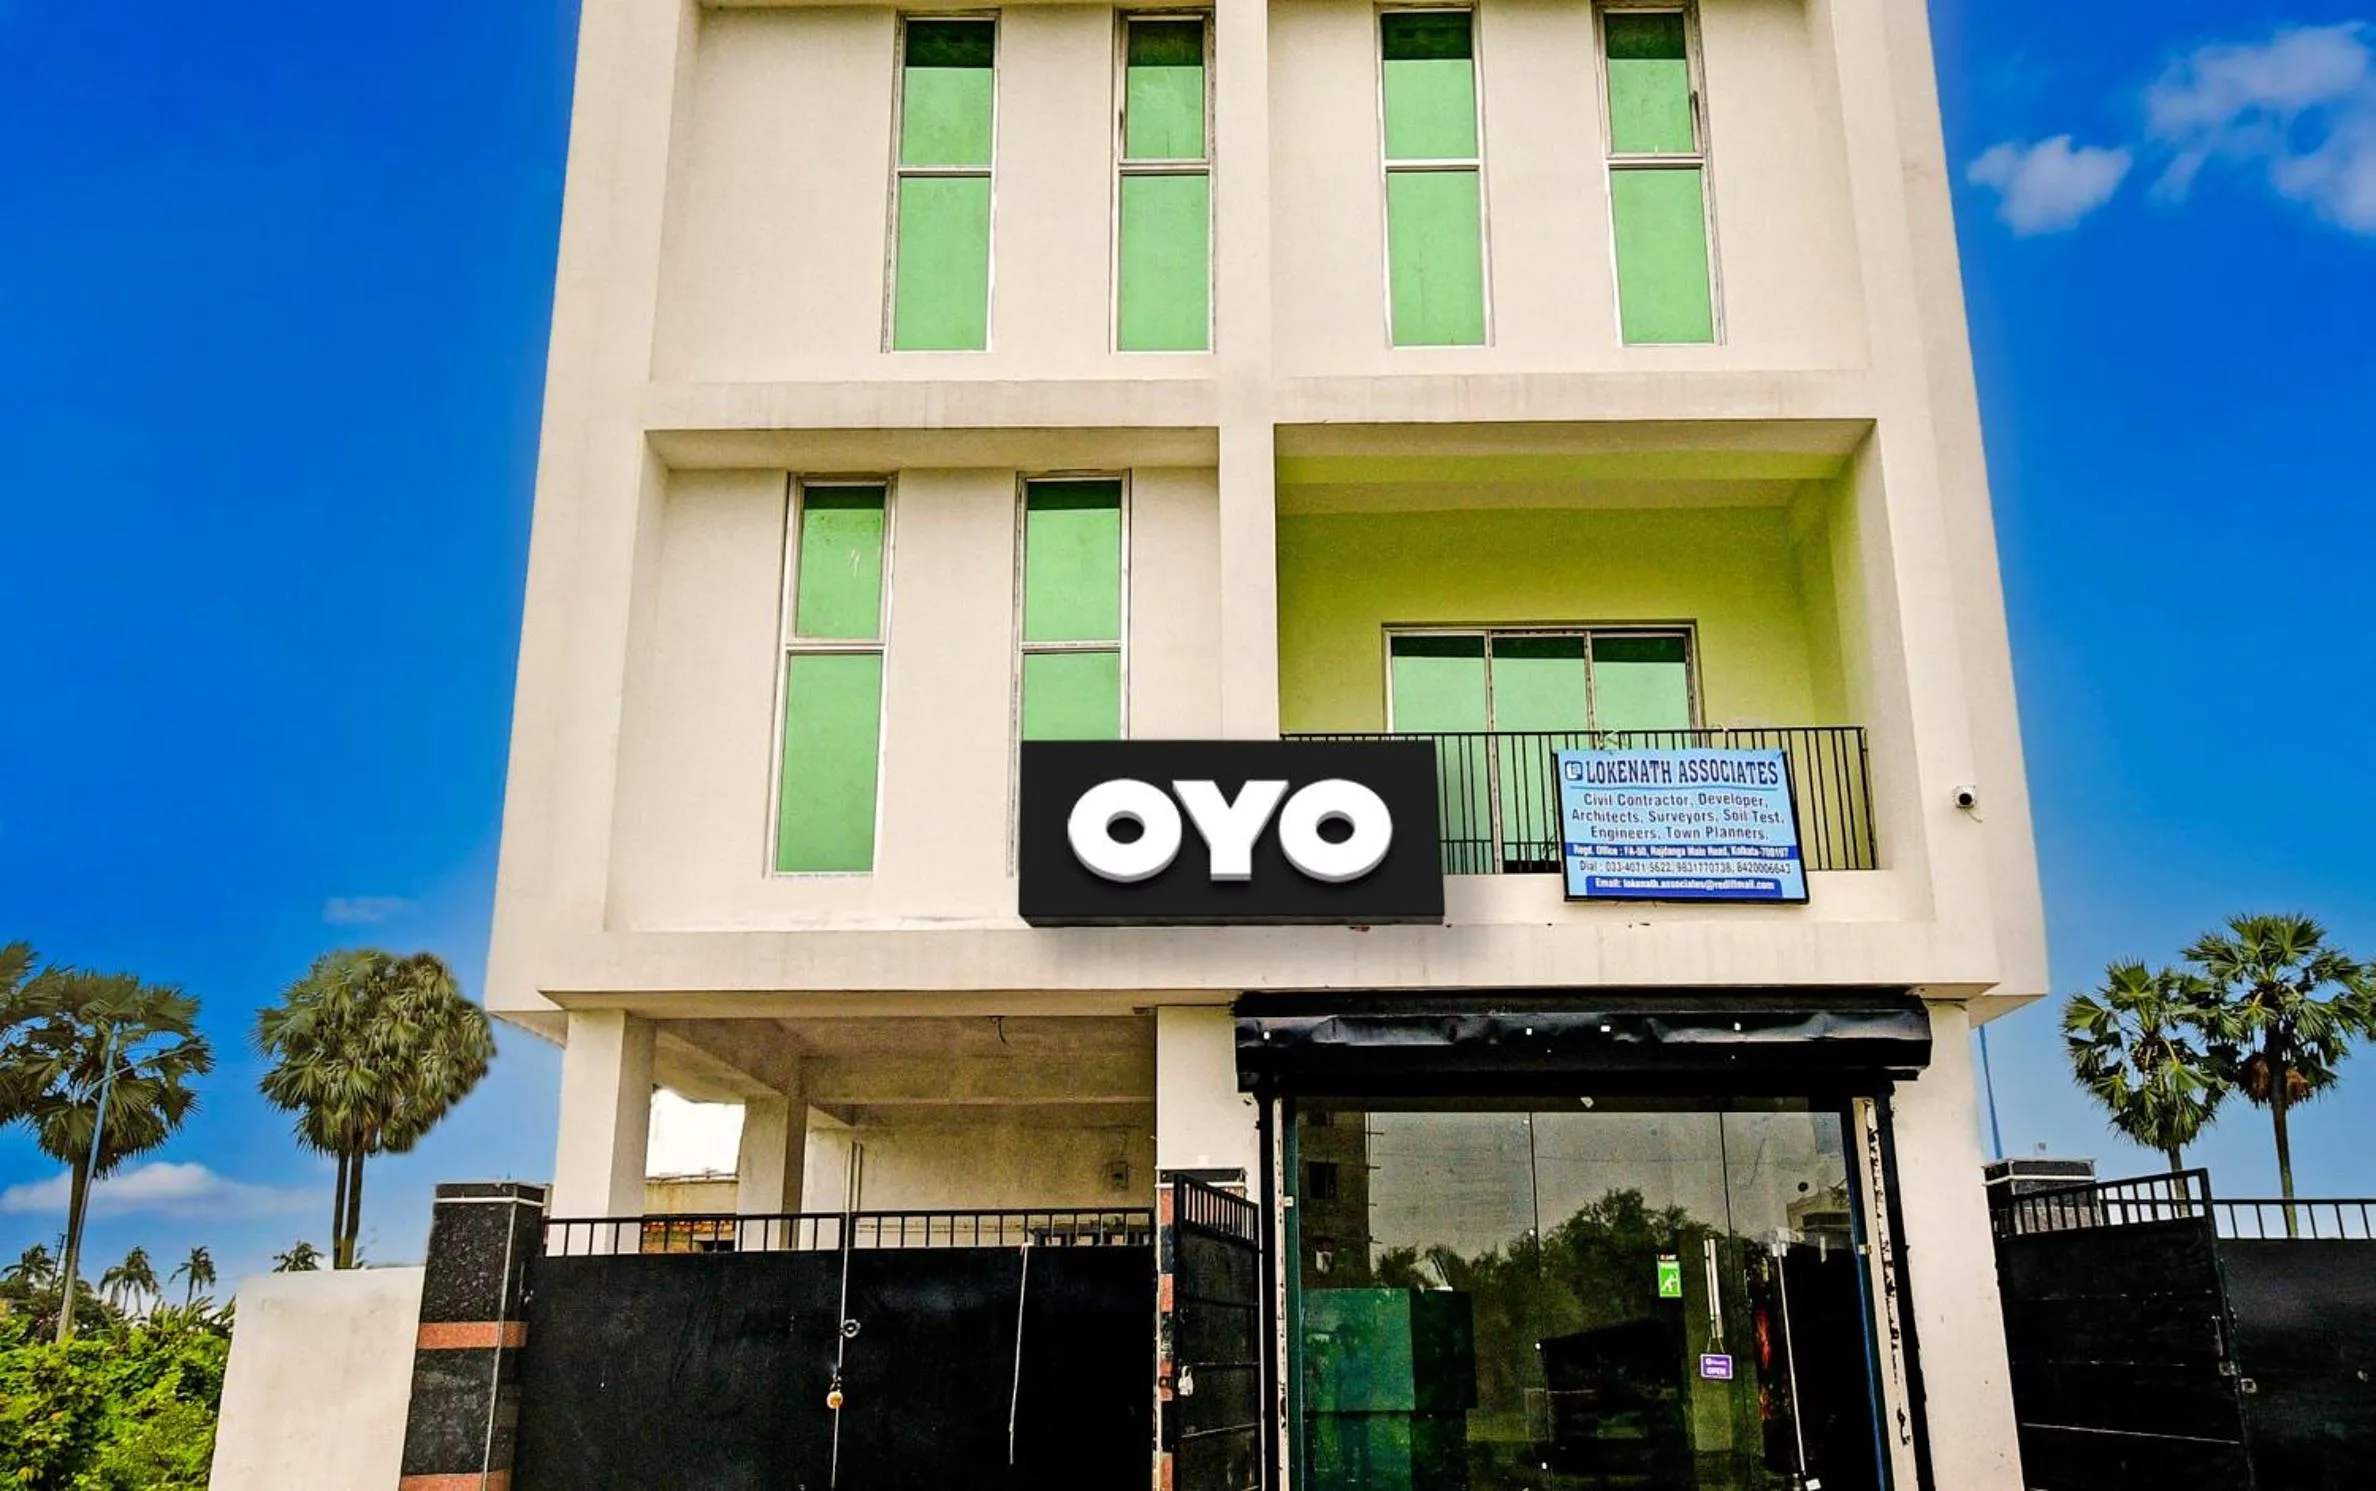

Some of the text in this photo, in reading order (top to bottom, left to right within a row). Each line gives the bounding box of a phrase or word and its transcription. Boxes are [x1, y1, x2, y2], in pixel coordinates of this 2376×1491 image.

[1586, 759, 1778, 785] LOKENATH ASSOCIATES
[1584, 793, 1768, 809] Civil Contractor, Developer,
[1723, 809, 1748, 821] Soil
[1067, 778, 1393, 883] OYO
[1666, 826, 1701, 839] Town
[1580, 860, 1597, 871] Dial
